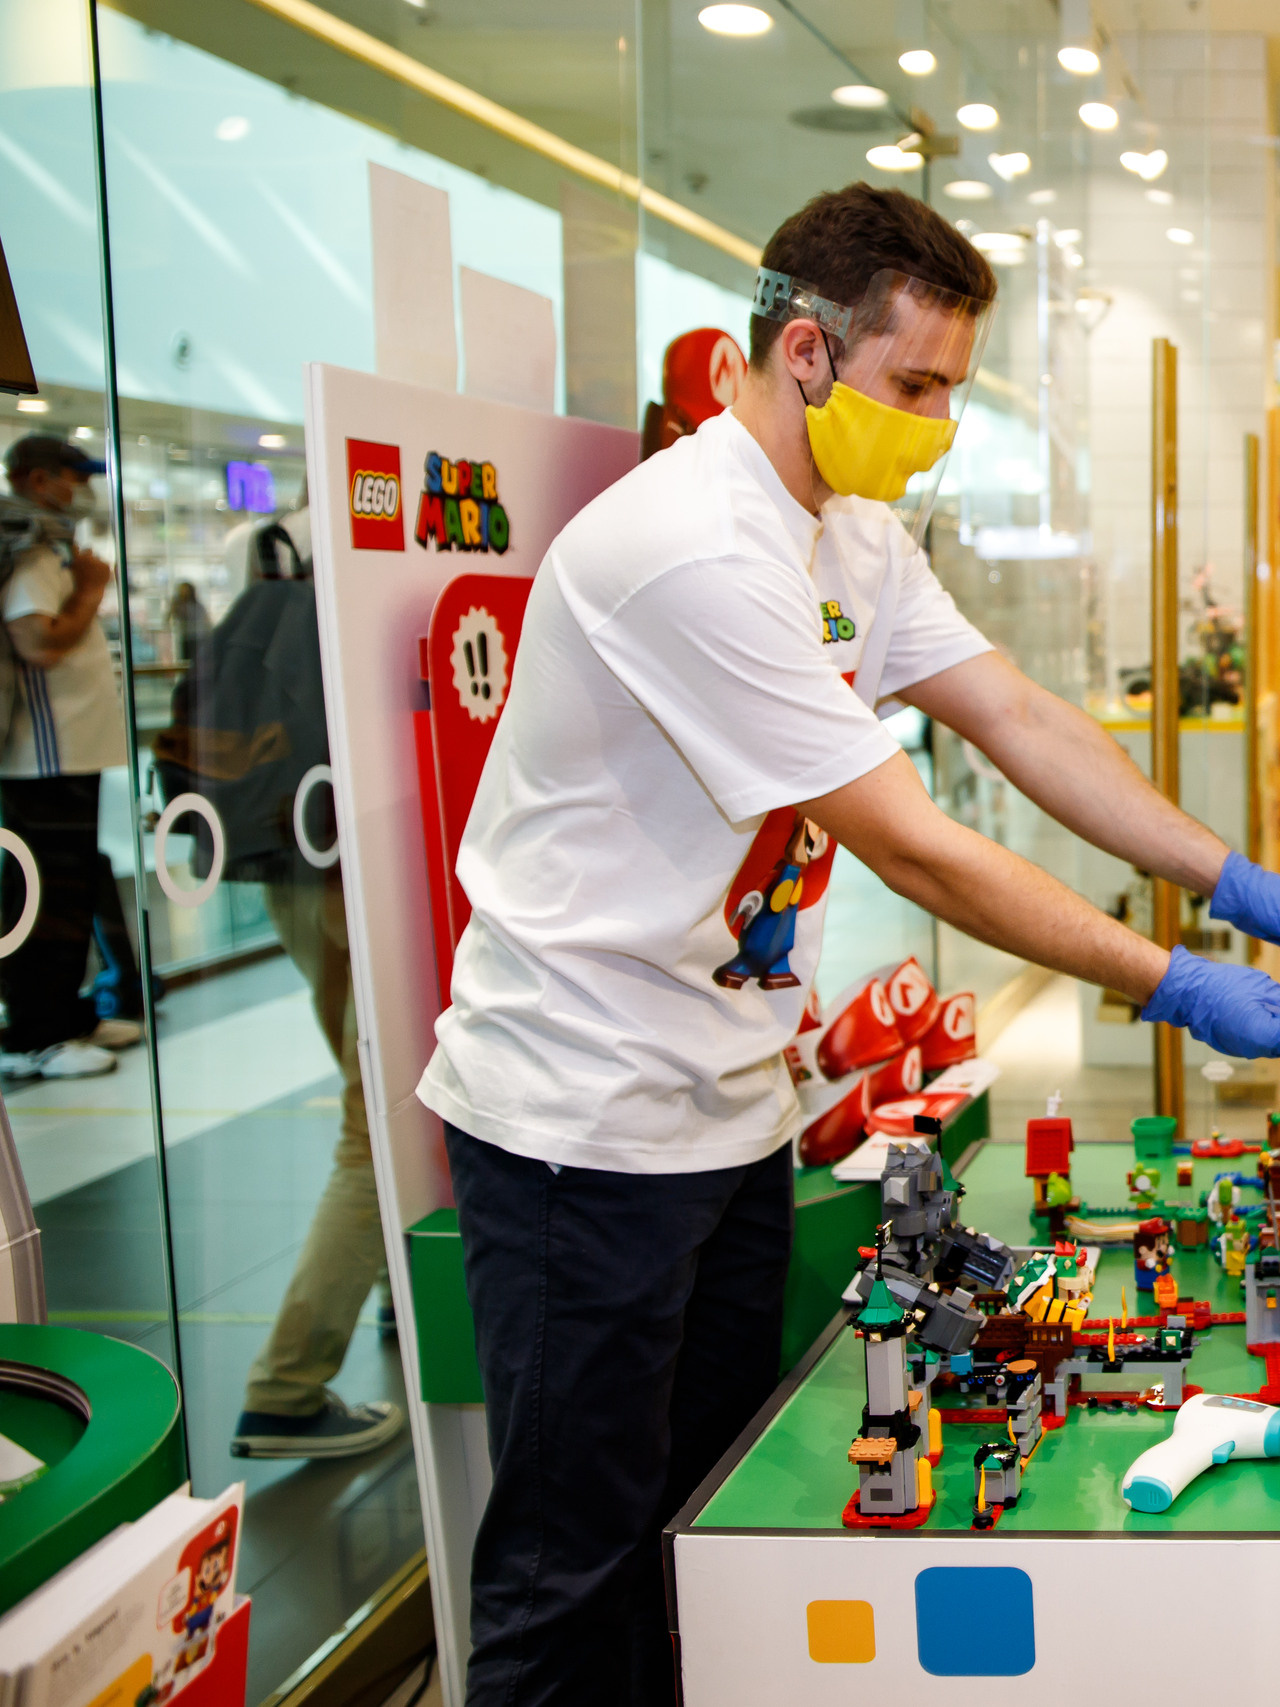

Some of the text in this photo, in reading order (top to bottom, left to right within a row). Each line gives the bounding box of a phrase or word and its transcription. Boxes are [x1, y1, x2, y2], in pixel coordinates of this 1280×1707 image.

[352, 470, 399, 521] LEGO
[425, 450, 498, 502] SUPER
[414, 490, 509, 555] MARIO
